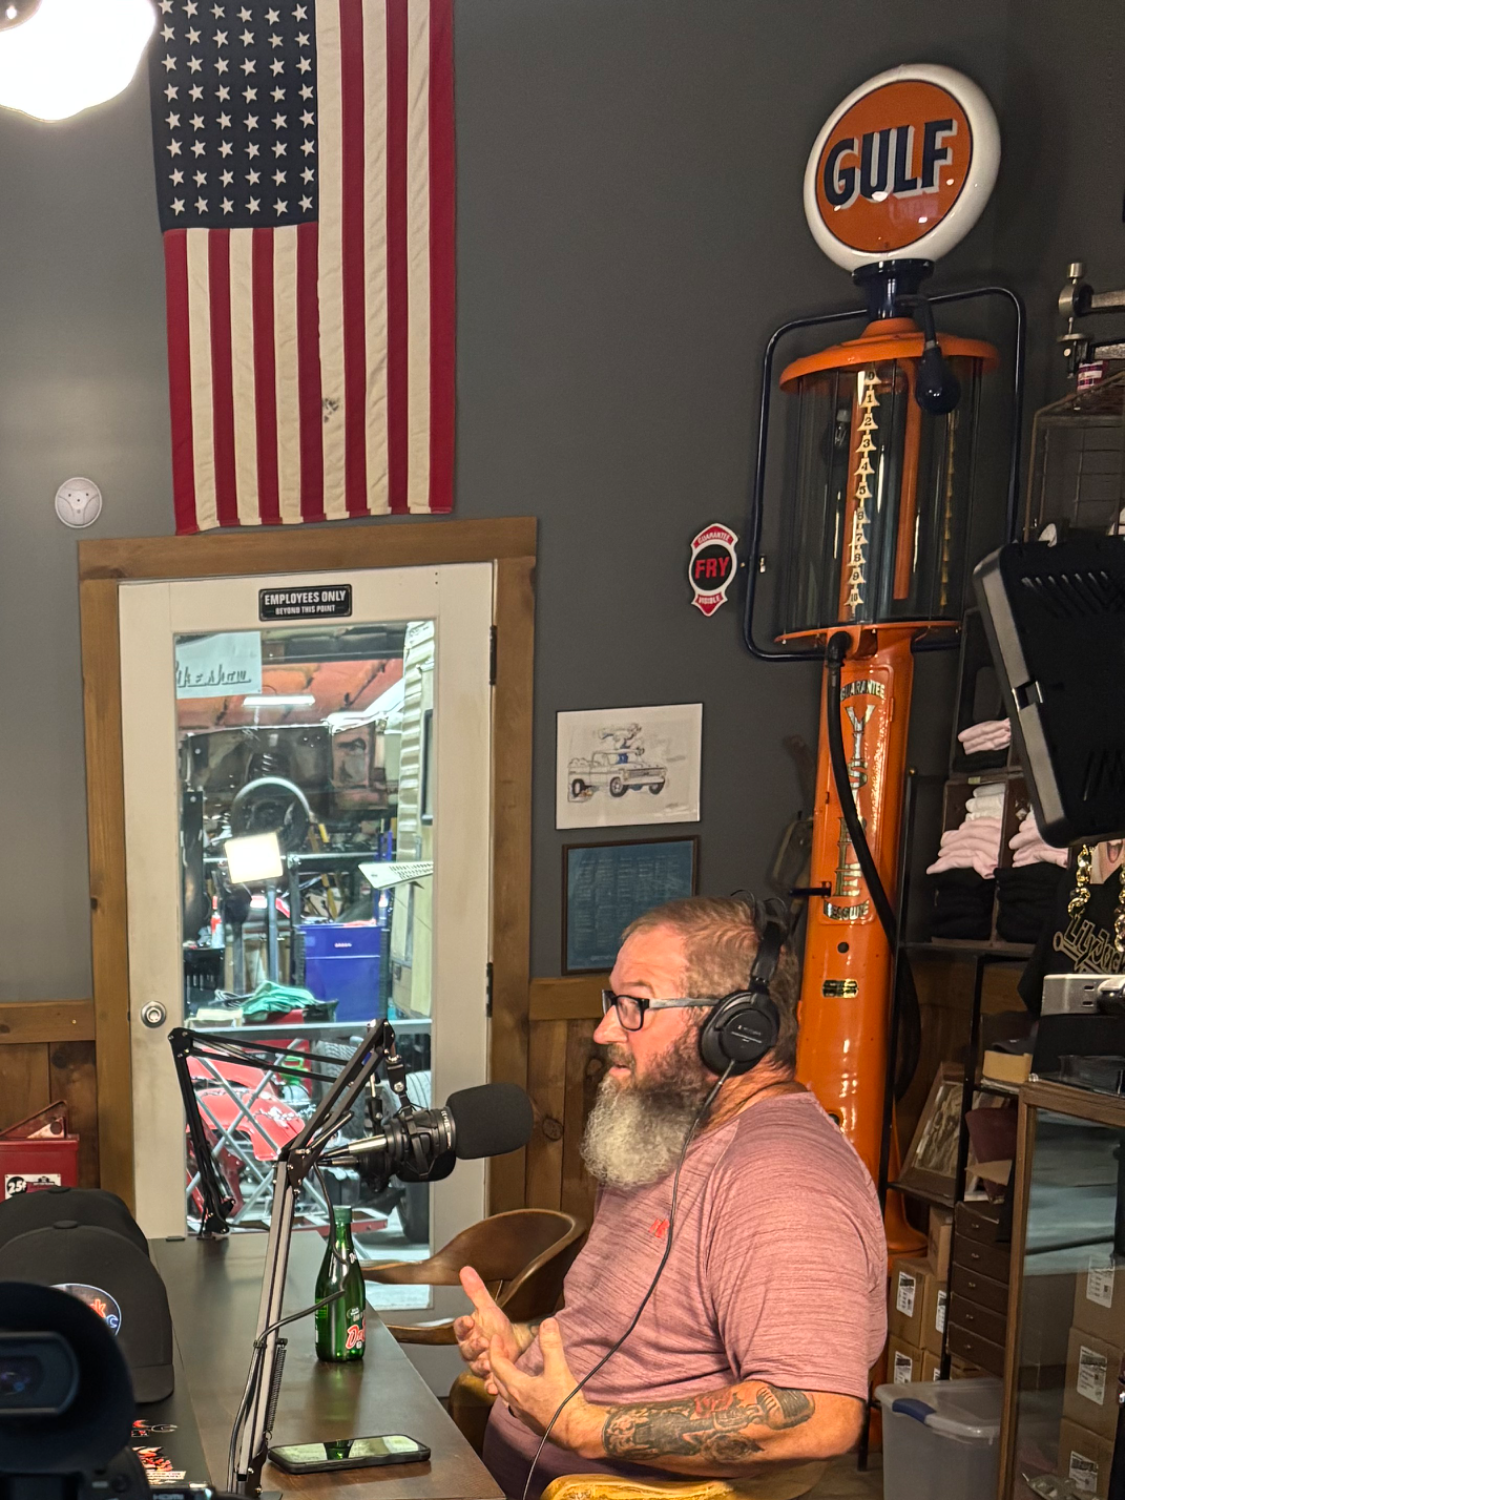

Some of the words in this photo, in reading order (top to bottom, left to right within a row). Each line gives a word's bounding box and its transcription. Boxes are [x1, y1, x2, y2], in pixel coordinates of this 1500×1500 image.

[823, 118, 958, 210] GULF
[694, 556, 730, 579] FRY
[264, 591, 320, 605] EMPLOYEES
[321, 590, 346, 602] ONLY
[698, 594, 721, 605] VISIBLE
[275, 607, 300, 615] BEYOND
[301, 605, 316, 614] THIS
[316, 604, 336, 613] POINT
